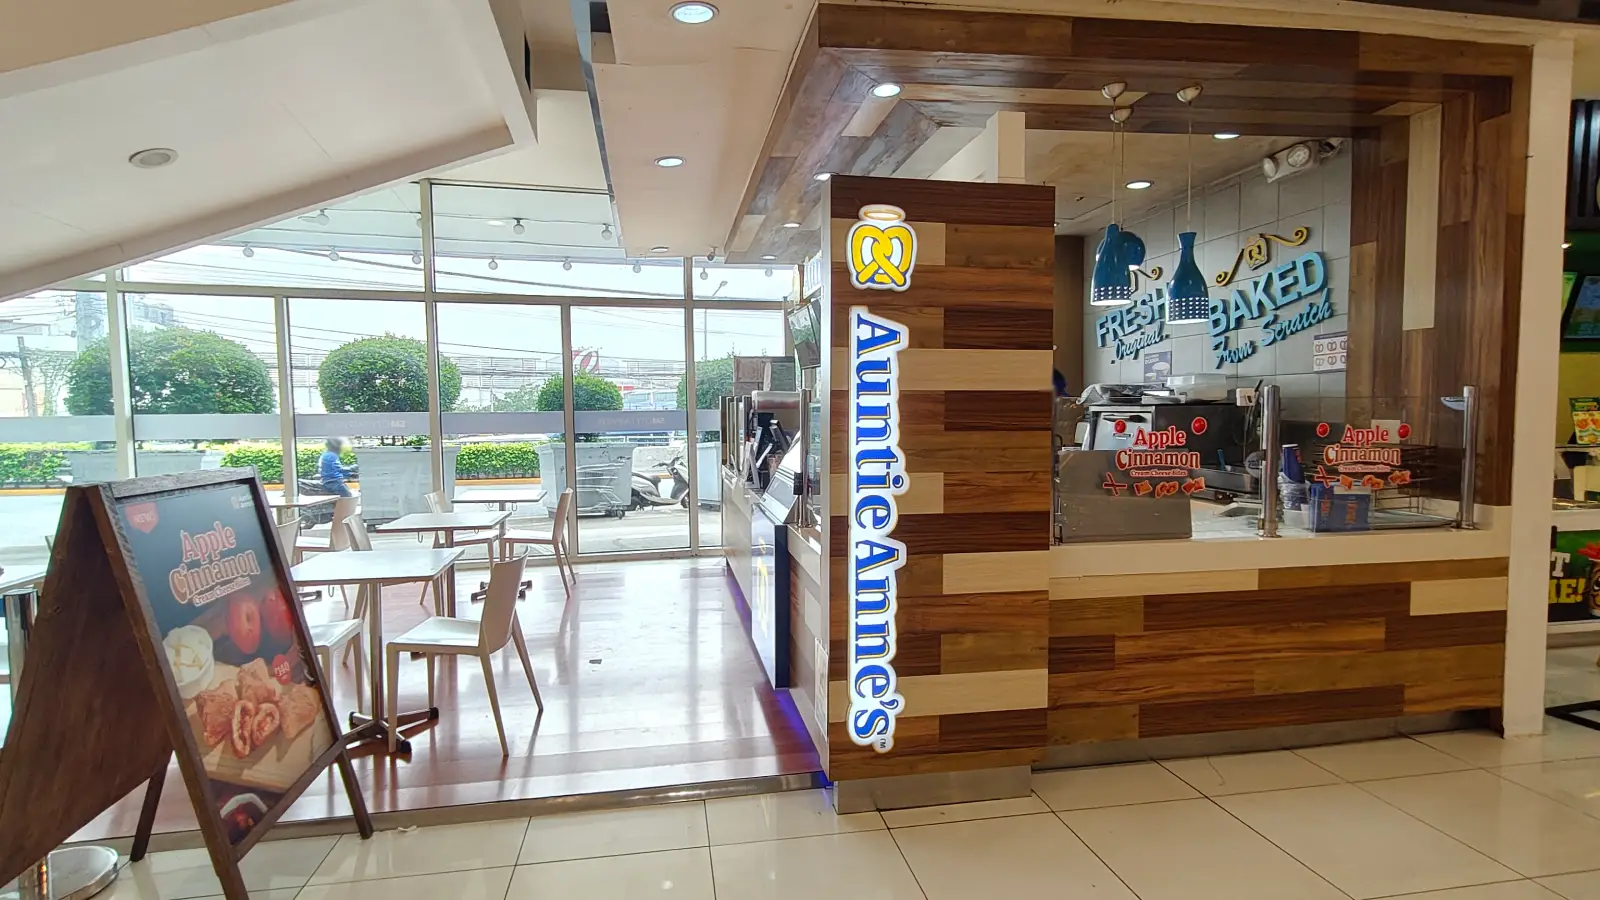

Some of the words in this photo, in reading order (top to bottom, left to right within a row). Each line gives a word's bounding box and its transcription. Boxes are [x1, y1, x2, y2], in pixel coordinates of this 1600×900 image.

[1095, 282, 1167, 347] FRESH
[1207, 250, 1325, 336] BAKED
[1114, 321, 1163, 360] Original
[1211, 336, 1253, 369] From
[1260, 287, 1332, 347] Scratch
[855, 313, 904, 530] Auntie
[1134, 427, 1186, 450] Apple
[1342, 424, 1390, 447] Apple
[1116, 449, 1200, 470] Cinnamon
[1324, 444, 1401, 465] Cinnamon
[180, 521, 236, 564] Apple
[169, 550, 260, 604] Cinnamon
[855, 539, 900, 739] Anne's
